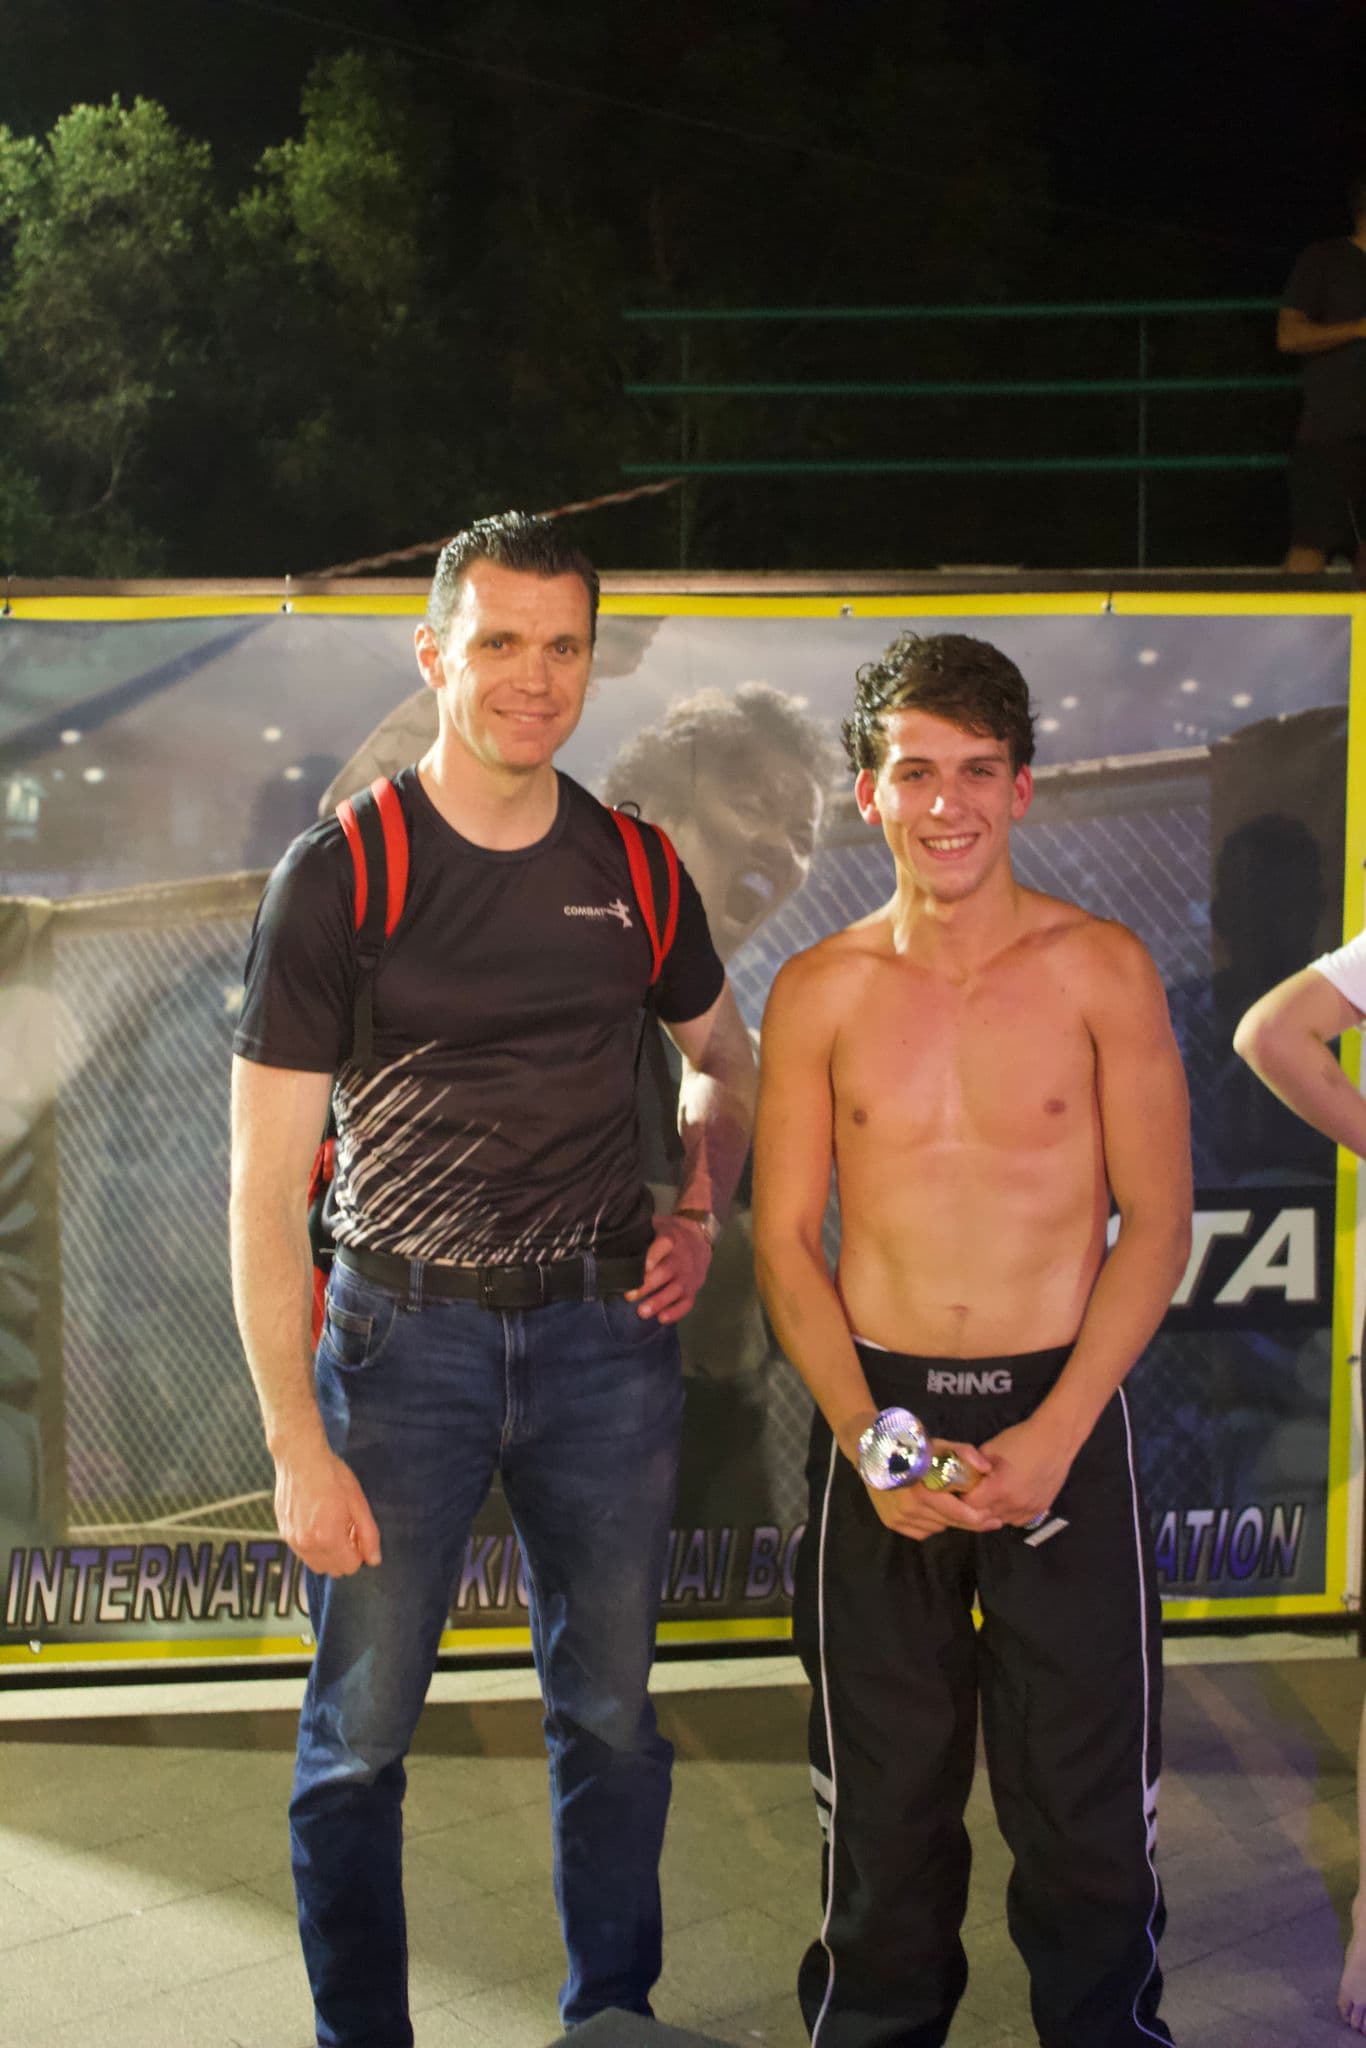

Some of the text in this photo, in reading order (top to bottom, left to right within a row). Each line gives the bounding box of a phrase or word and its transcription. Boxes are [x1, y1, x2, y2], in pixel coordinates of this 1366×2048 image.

[563, 904, 607, 918] COMBAT
[1107, 1207, 1317, 1305] TA
[936, 1369, 1013, 1395] RING
[1154, 1504, 1303, 1579] ATION
